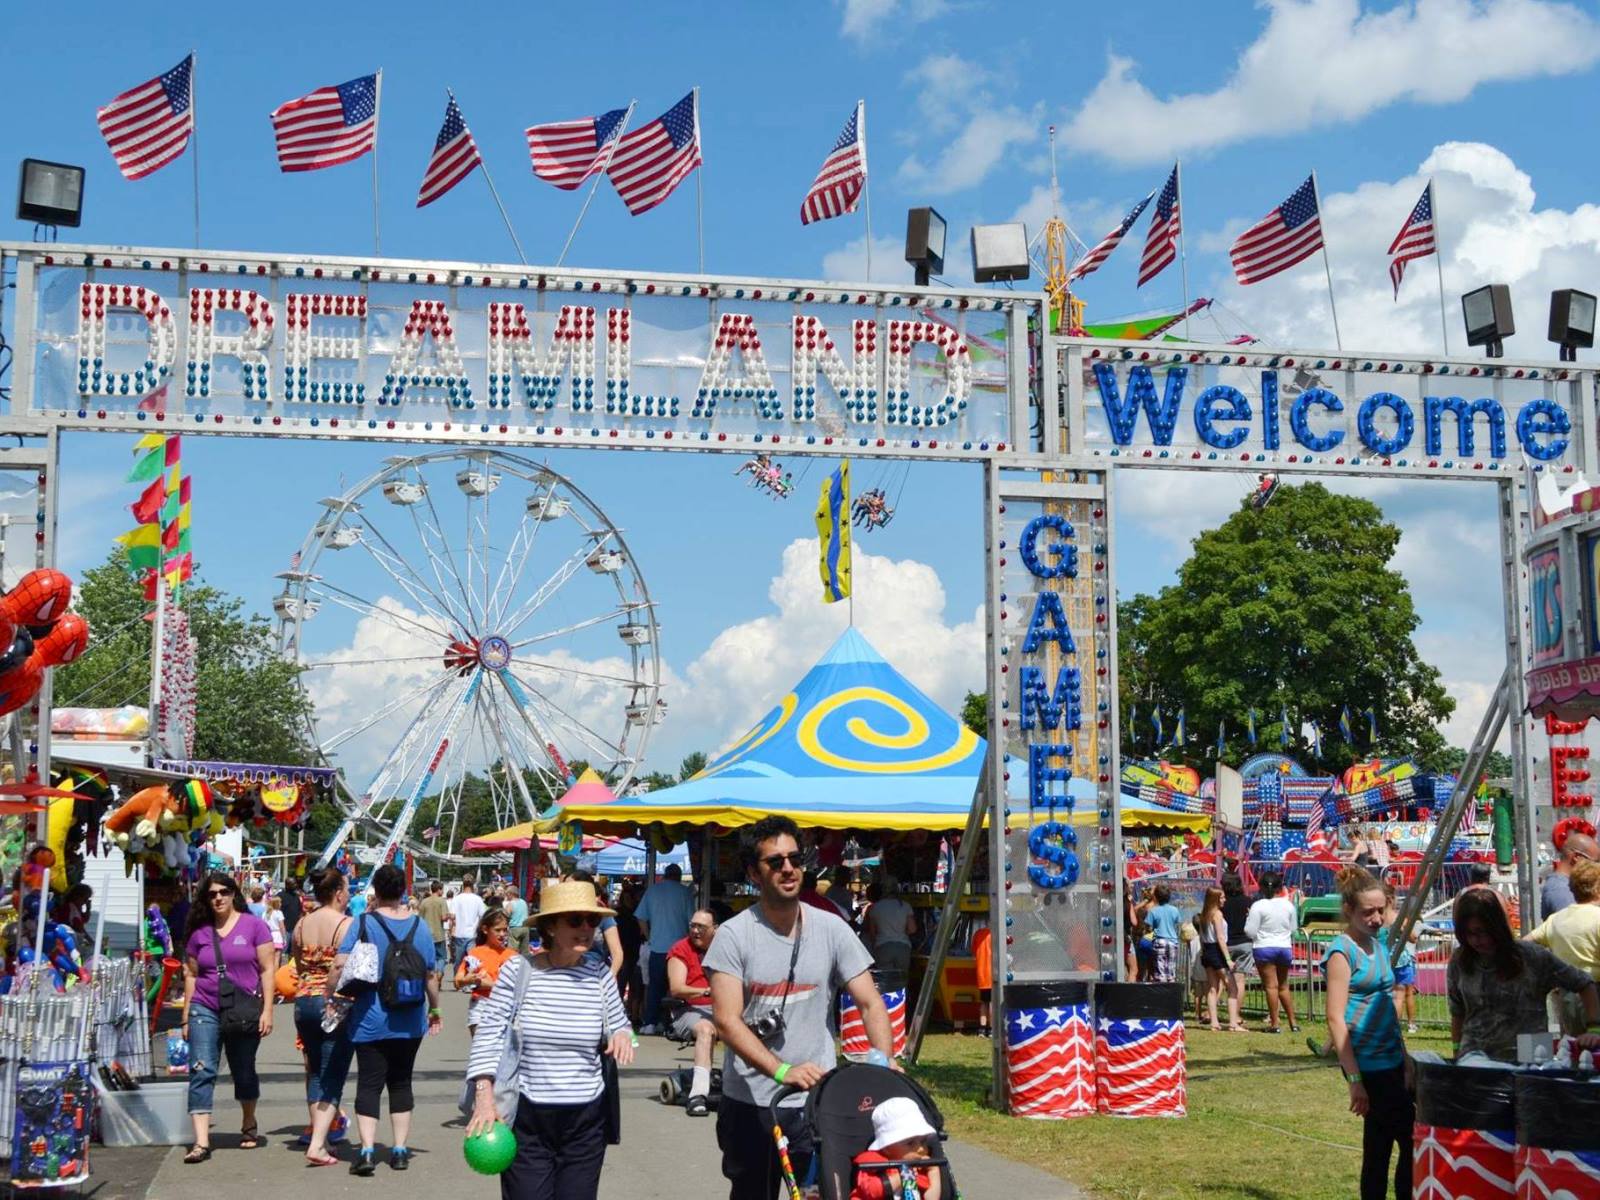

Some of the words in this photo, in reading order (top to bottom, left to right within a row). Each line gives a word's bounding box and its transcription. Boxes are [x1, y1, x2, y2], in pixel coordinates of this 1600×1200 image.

[77, 283, 972, 428] DREAMLAND
[1093, 363, 1572, 461] Welcome
[1019, 514, 1081, 889] GAMES
[19, 1067, 66, 1082] SWAT
